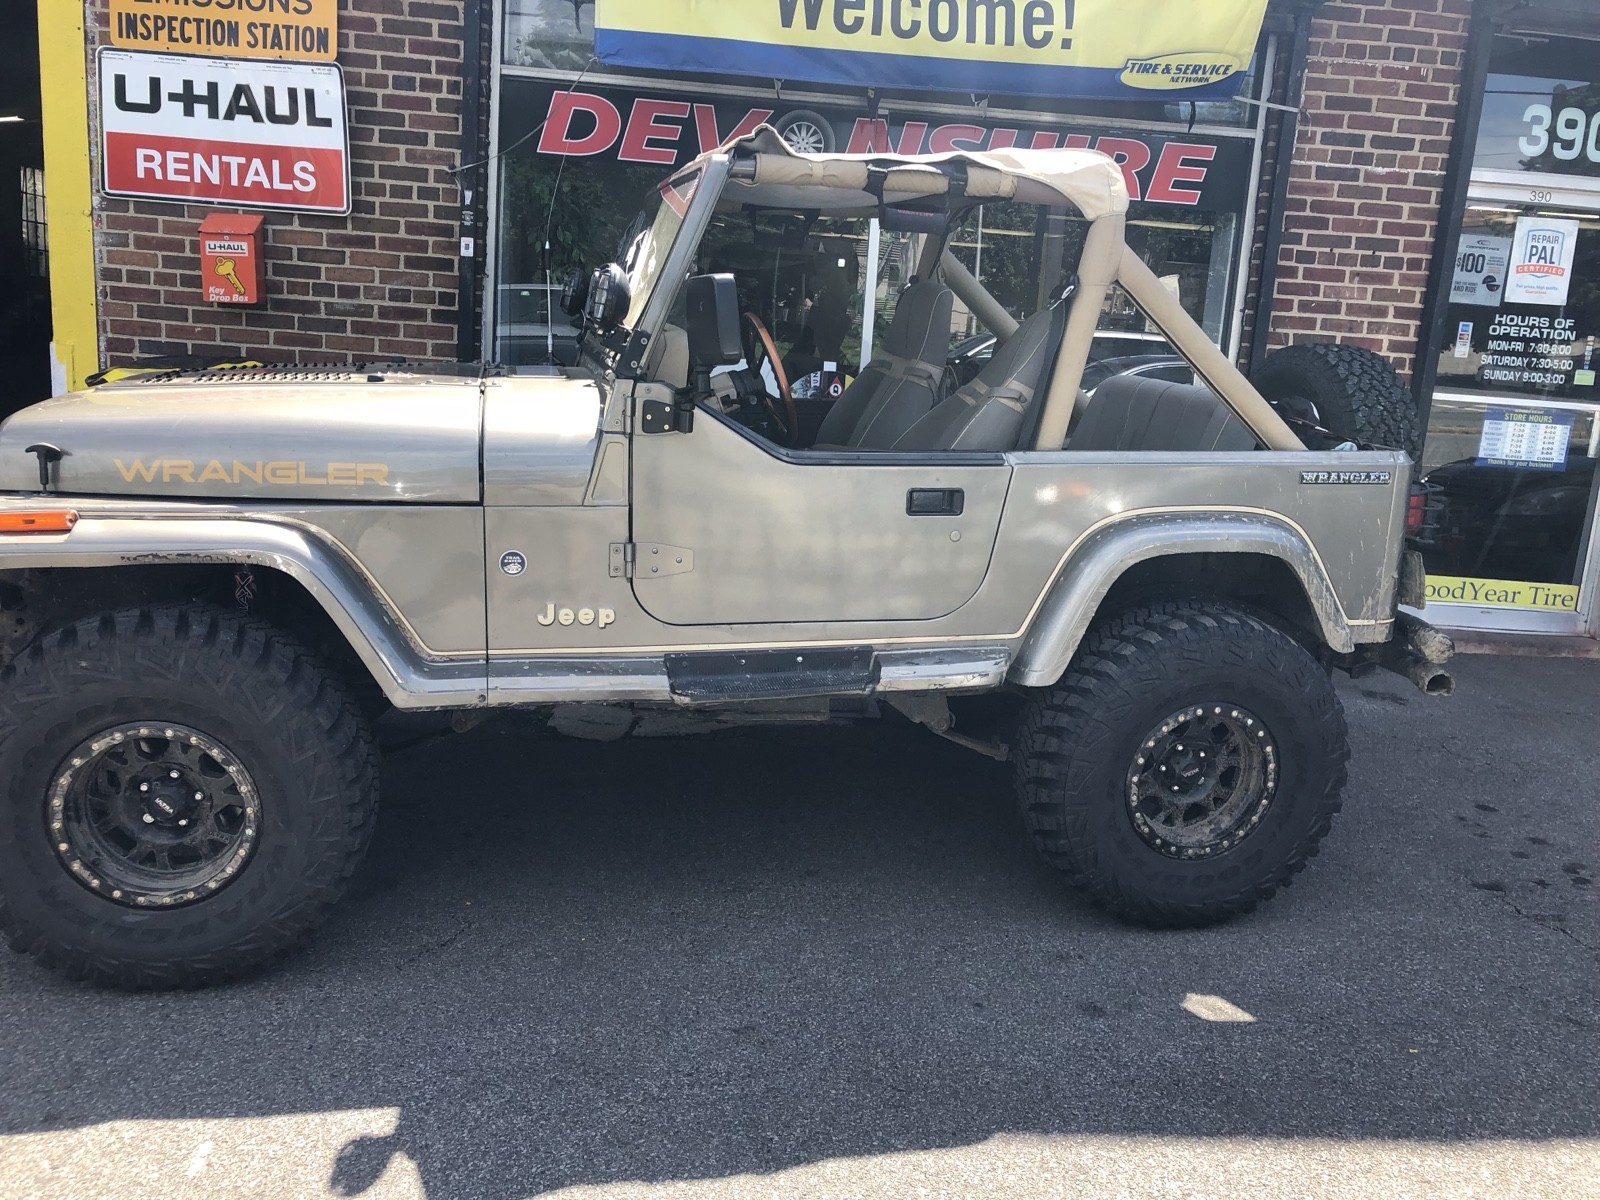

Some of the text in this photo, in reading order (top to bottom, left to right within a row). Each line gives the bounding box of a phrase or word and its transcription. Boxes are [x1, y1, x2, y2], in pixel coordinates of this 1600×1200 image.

[117, 12, 329, 53] INSPECTION STATION
[1129, 62, 1232, 75] TIRE & SERVICE
[114, 73, 333, 128] U-HAUL
[136, 148, 316, 192] RENTALS
[1529, 191, 1552, 203] 390
[208, 243, 245, 251] U-HAUL
[1531, 234, 1560, 245] REPAIR
[1528, 245, 1556, 264] PAL
[1456, 252, 1486, 273] $100
[1518, 265, 1563, 275] CERTIFIED
[209, 286, 225, 295] Key
[209, 294, 249, 302] Drop Box
[1495, 314, 1575, 329] HOURS OF
[1489, 325, 1576, 340] OPERATION
[1488, 340, 1572, 355] MON-FRI 7:30-6:00
[1481, 355, 1573, 370] SATURDAY 7:30-5:00
[1484, 369, 1565, 384] SUNDAY 9:00-3:00
[1504, 413, 1553, 423] STORE HOURS
[113, 458, 389, 486] WRANGLER
[1301, 472, 1390, 484] WRANGLER
[1425, 581, 1574, 608] oodYear Tire
[537, 603, 616, 629] Jeep
